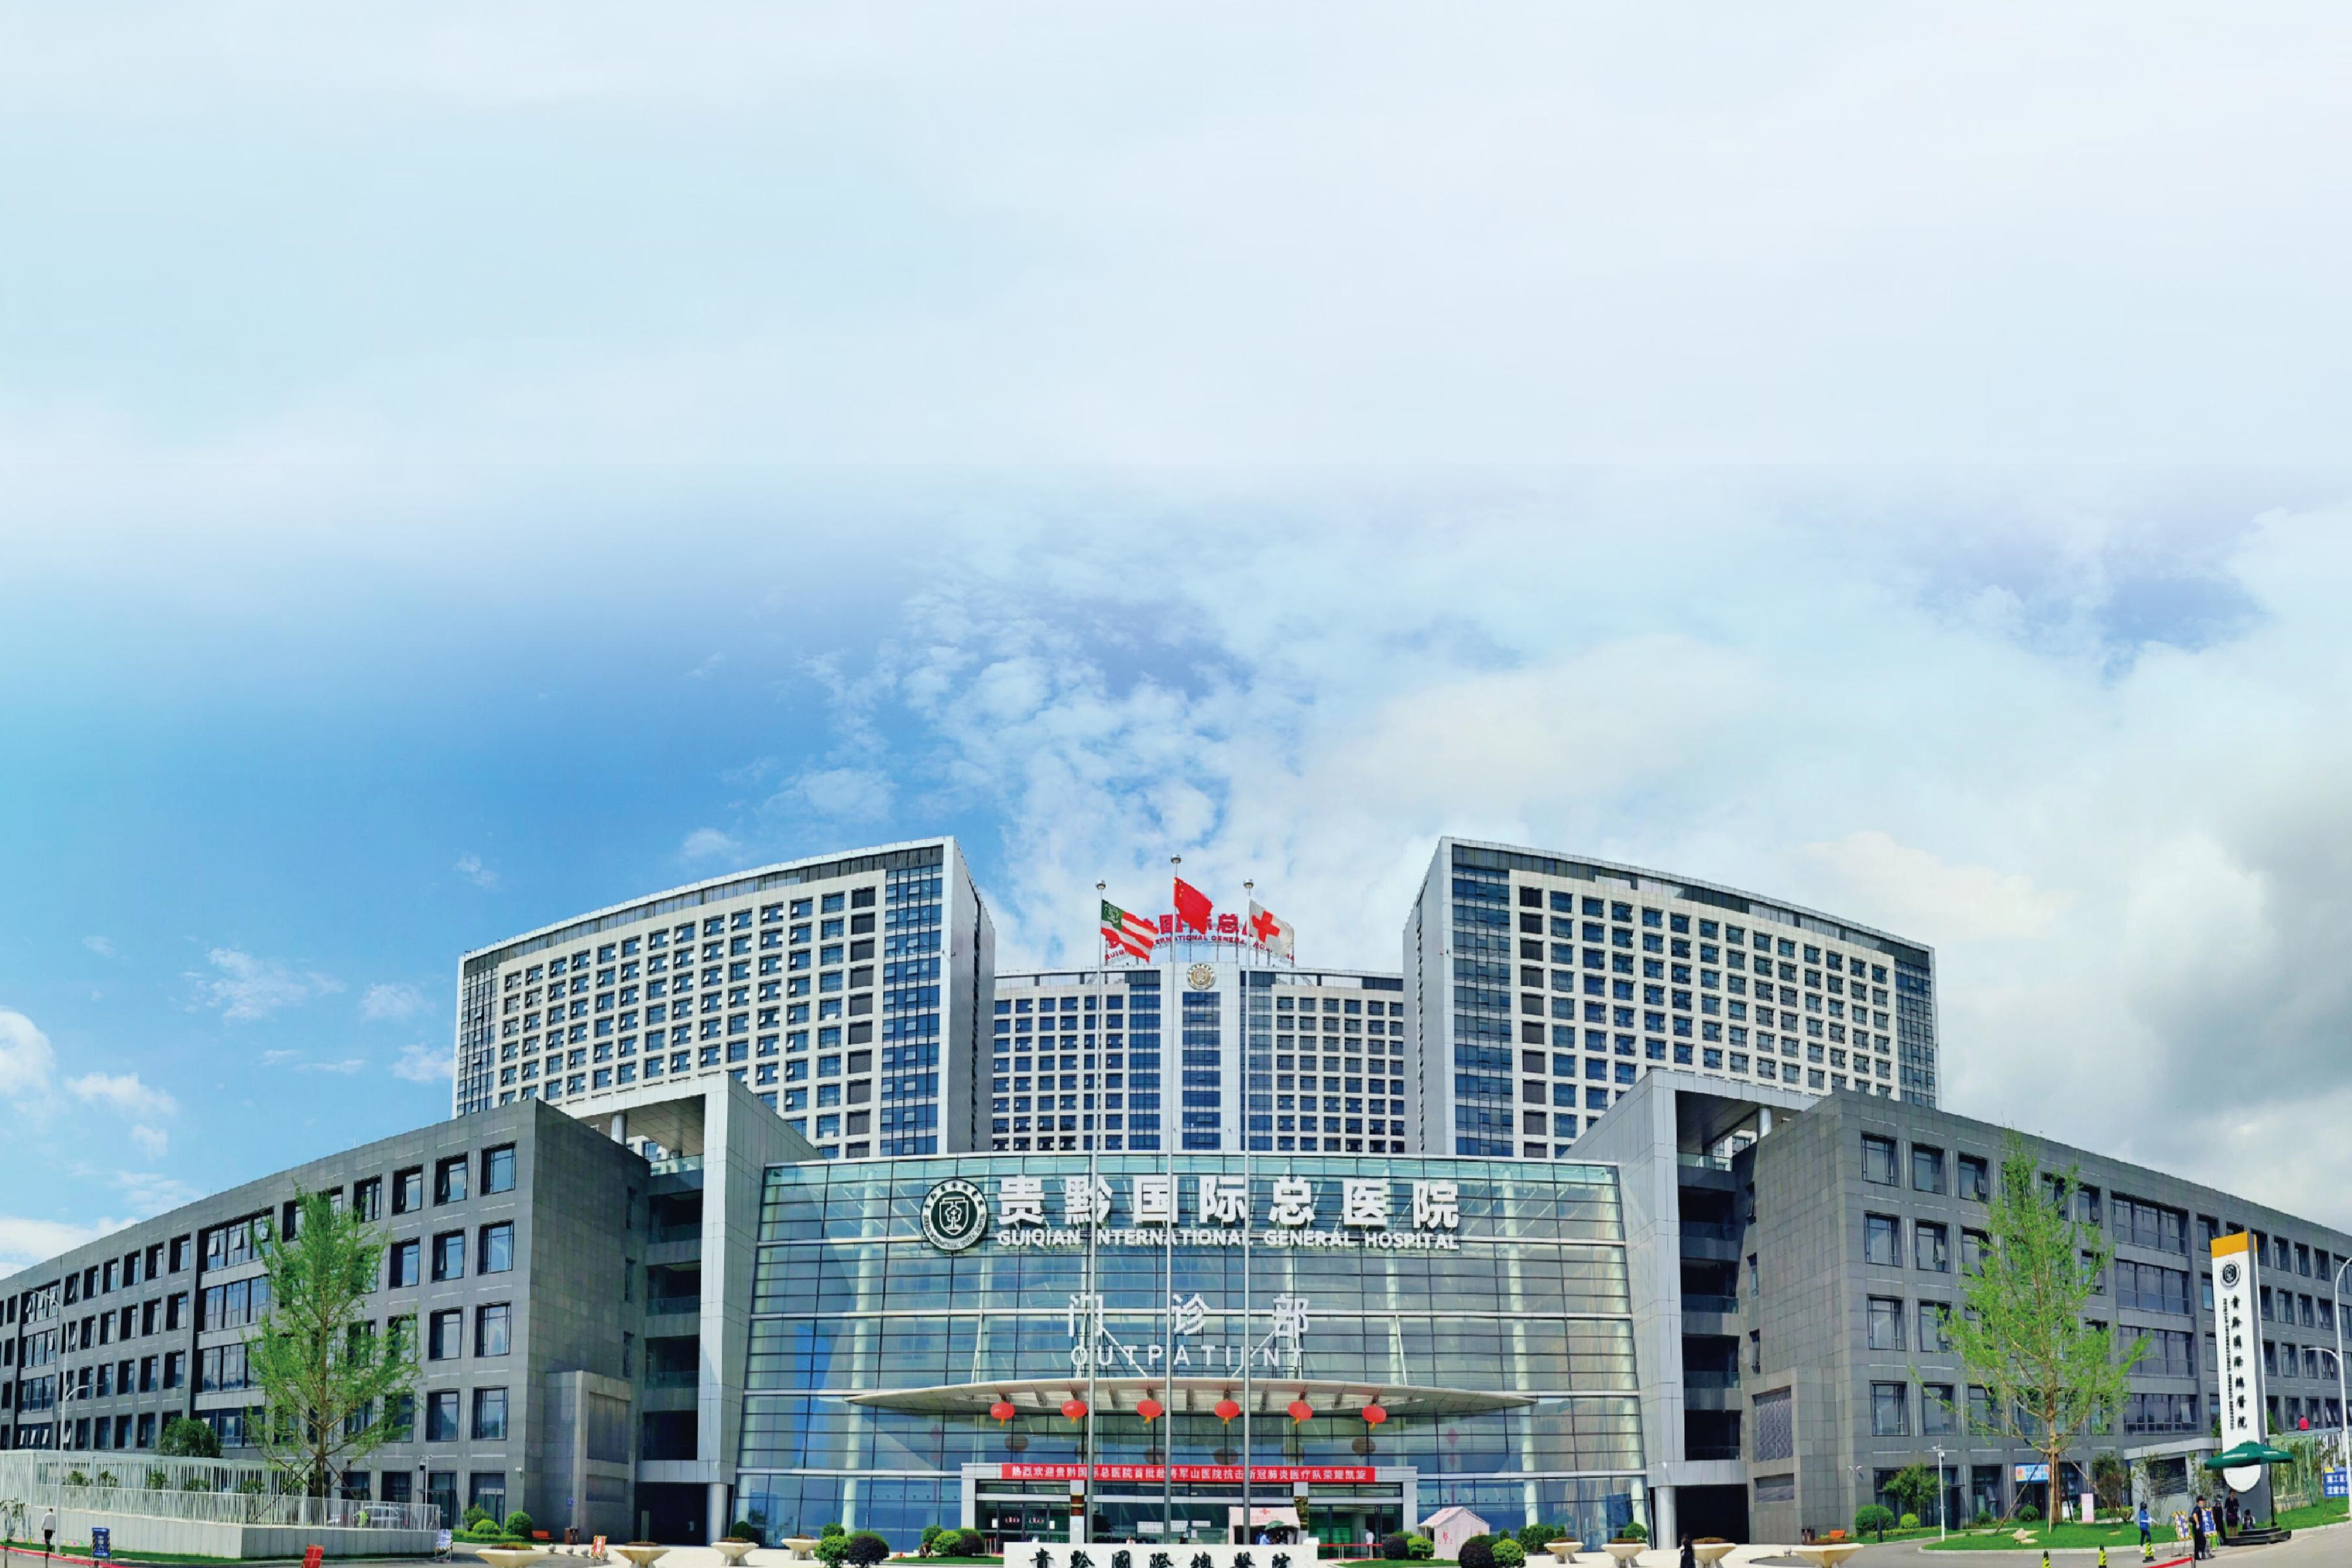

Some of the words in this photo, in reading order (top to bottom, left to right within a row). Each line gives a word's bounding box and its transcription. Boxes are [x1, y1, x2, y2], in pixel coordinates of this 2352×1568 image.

[998, 1175, 1460, 1229] 贵黔国际总医院
[998, 1229, 1081, 1246] GUIQIAN
[1096, 1229, 1253, 1247] NTERNATIONAL
[1264, 1230, 1355, 1247] GENERAL
[1365, 1232, 1460, 1250] HOSPITAL
[1068, 1293, 1309, 1338] 门诊部
